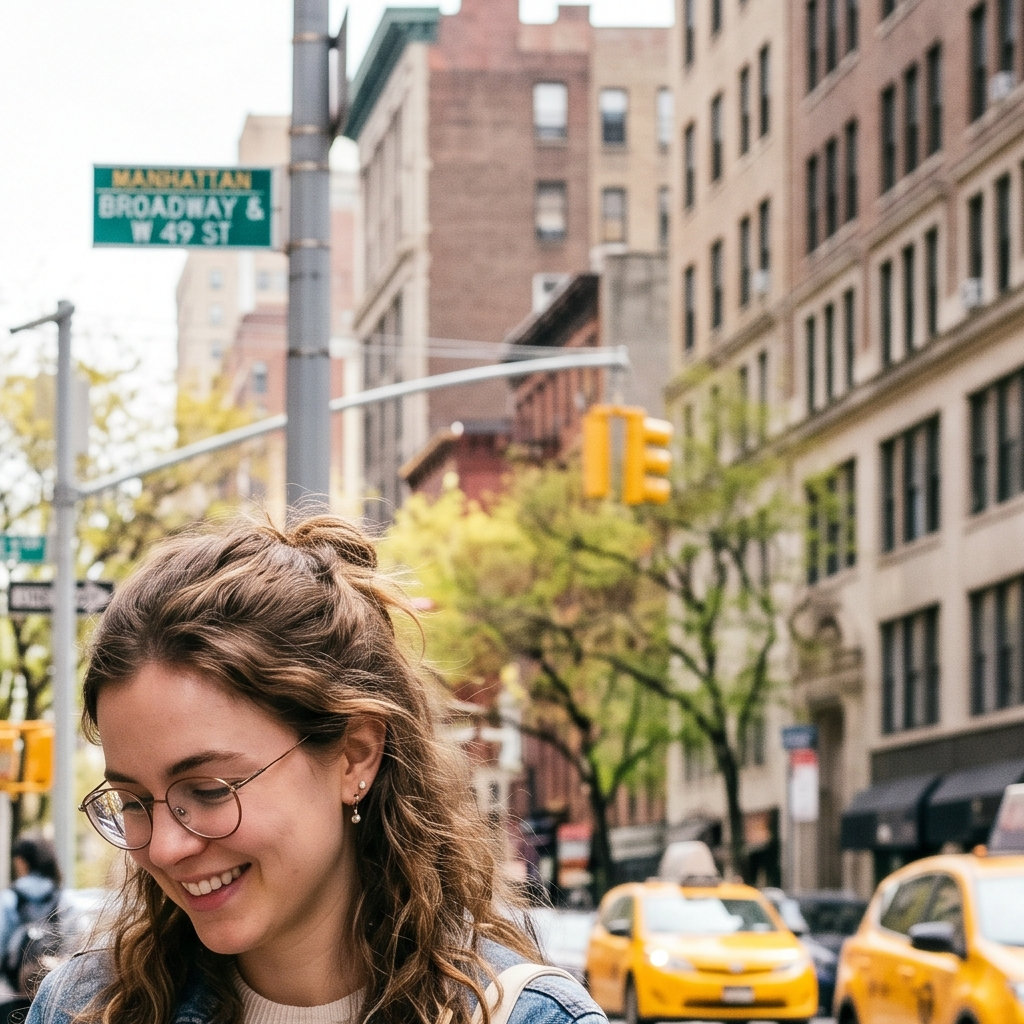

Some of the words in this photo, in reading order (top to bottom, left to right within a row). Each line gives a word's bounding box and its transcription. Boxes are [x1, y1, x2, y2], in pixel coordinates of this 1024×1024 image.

[112, 169, 252, 189] MANHATTAN
[98, 194, 237, 220] BROADWAY
[245, 197, 265, 221] &
[130, 220, 153, 243] W
[159, 220, 195, 244] 49
[201, 221, 232, 245] ST
